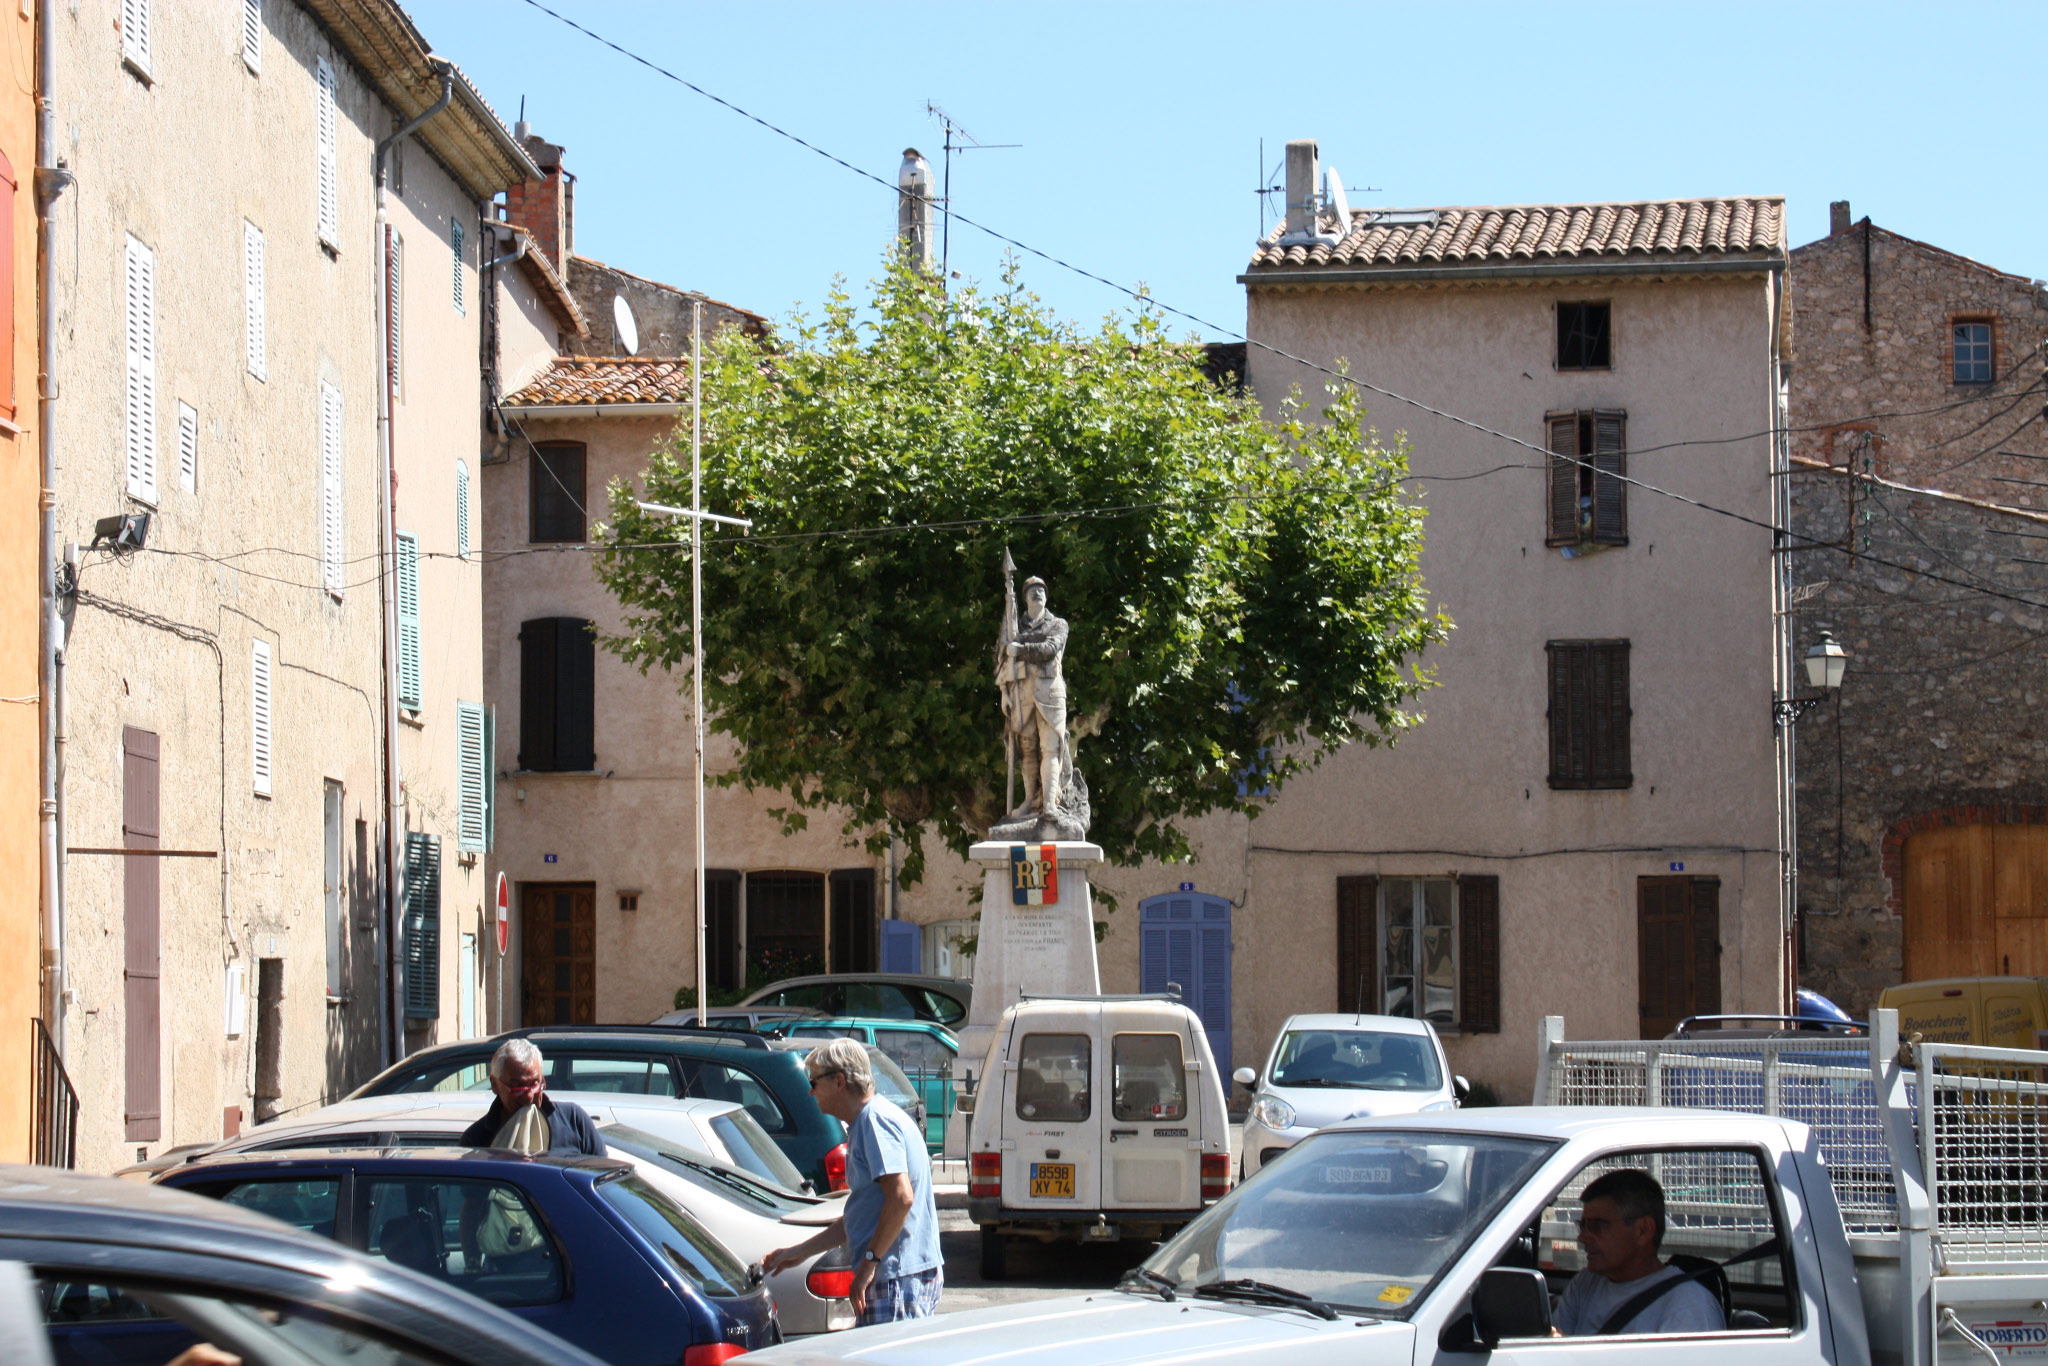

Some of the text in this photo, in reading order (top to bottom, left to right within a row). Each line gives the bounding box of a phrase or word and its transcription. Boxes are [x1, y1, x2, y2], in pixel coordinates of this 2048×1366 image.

[1015, 860, 1053, 889] RF
[1904, 1013, 1967, 1031] Boucherie
[1039, 1166, 1069, 1179] 8598
[1035, 1180, 1071, 1194] XY 74
[1974, 1328, 2047, 1343] ROBERTO
